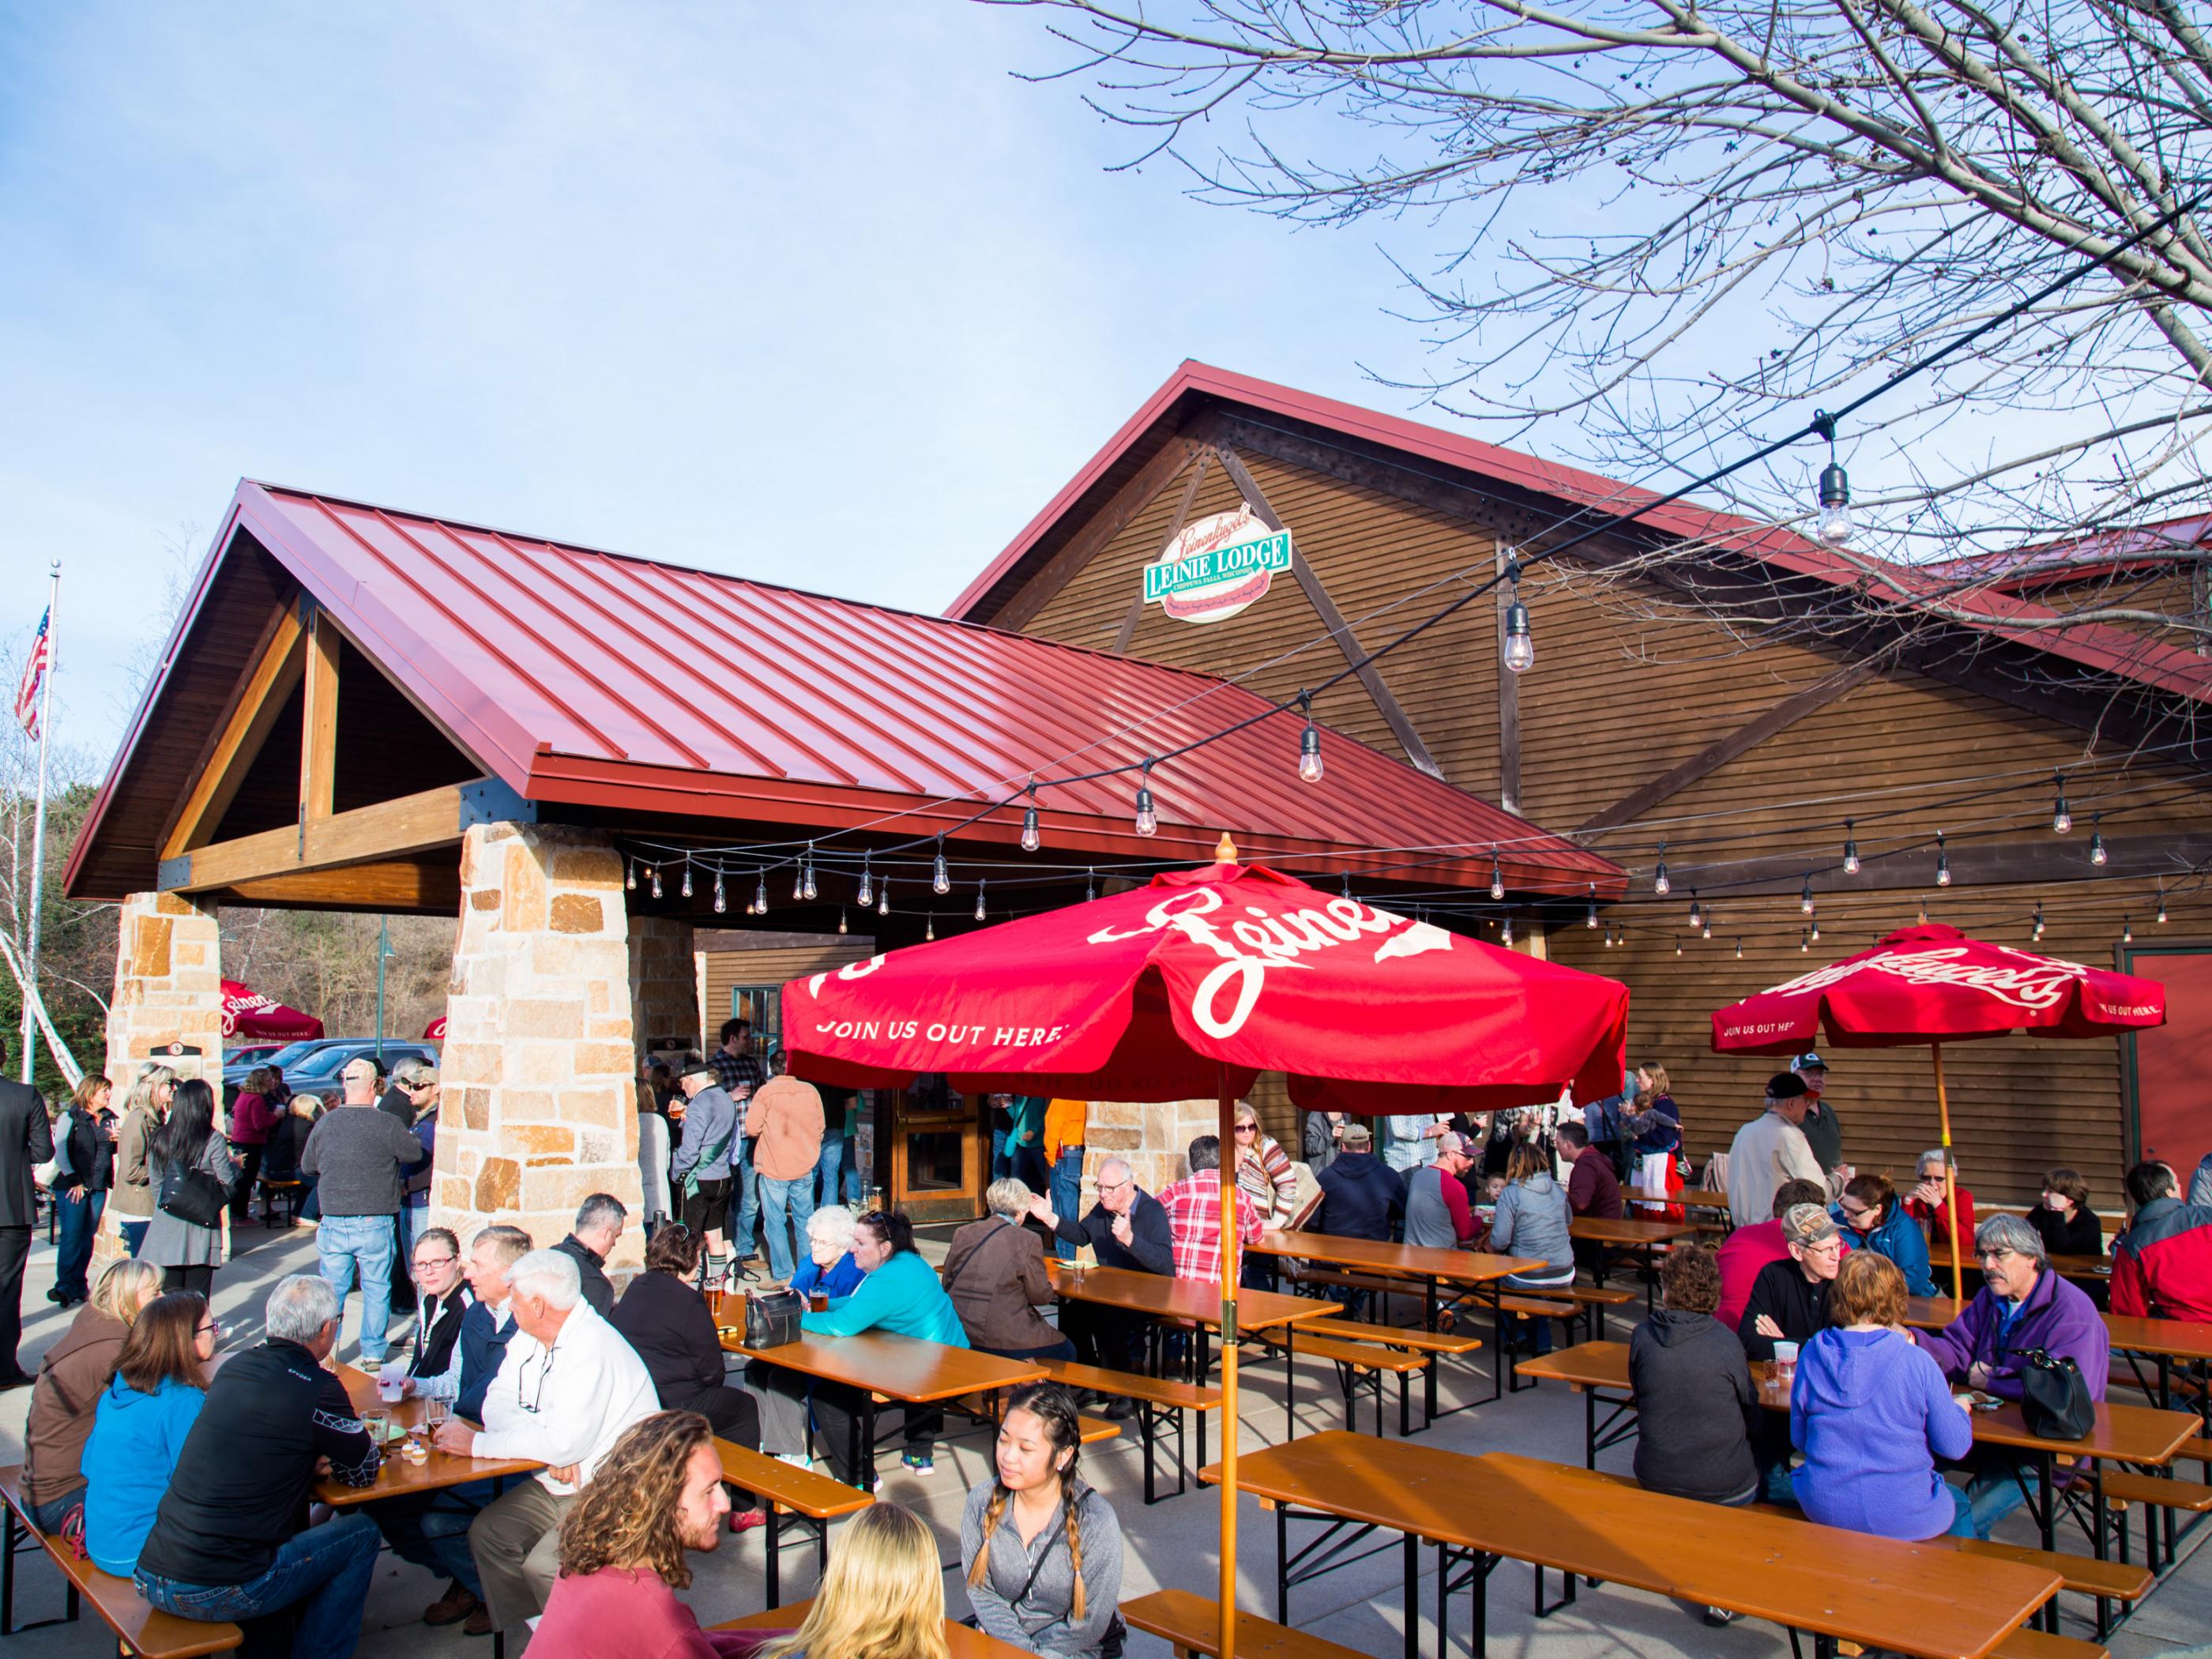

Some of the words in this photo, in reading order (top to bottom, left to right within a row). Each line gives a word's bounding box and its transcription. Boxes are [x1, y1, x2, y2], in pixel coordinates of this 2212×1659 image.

[1149, 555, 1211, 596] LEINIE
[1217, 536, 1284, 572] LODGE
[2108, 1005, 2116, 1015] US
[2118, 1006, 2131, 1016] OUT
[816, 1021, 880, 1040] JOIN
[888, 1021, 919, 1039] US
[927, 1023, 986, 1044] OUT
[1724, 1026, 1740, 1036] JOIN
[1743, 1025, 1755, 1034] US
[1757, 1023, 1775, 1033] OUT
